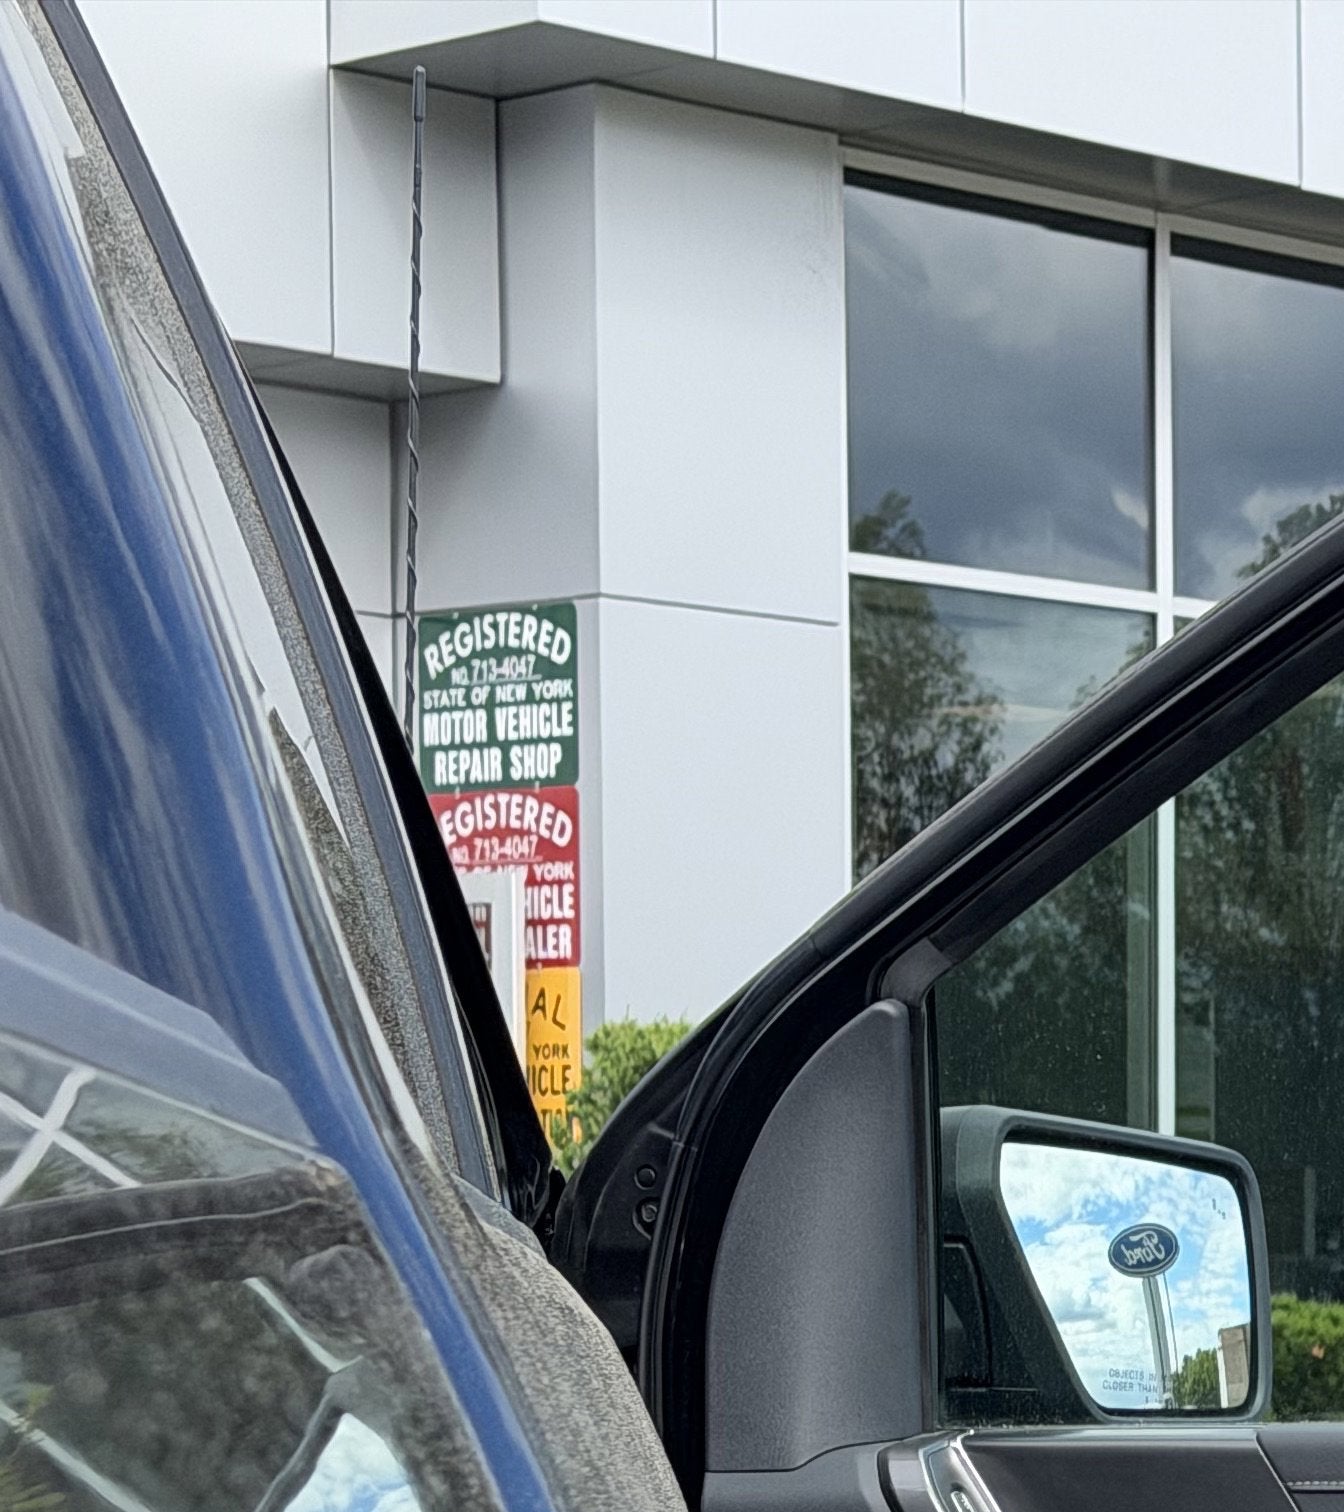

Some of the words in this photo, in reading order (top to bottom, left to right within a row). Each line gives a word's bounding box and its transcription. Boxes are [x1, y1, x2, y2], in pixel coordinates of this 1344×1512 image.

[424, 612, 572, 680] REGISTERED
[471, 654, 536, 684] 713-4047
[423, 687, 467, 710] STATE
[471, 684, 491, 706] OF
[496, 681, 527, 705] NEW
[532, 678, 574, 700] YORK
[423, 709, 488, 747] MOTOR
[495, 700, 574, 741] VEHICLE
[434, 746, 503, 786] REPAIR
[510, 742, 563, 781] SHOP
[440, 793, 573, 848] EGISTERED
[473, 834, 539, 861] 713-4047
[532, 861, 575, 882] YORK
[532, 1042, 570, 1061] YORK
[1102, 1379, 1134, 1392] CLOSER
[1108, 1367, 1145, 1381] OBJECTS
